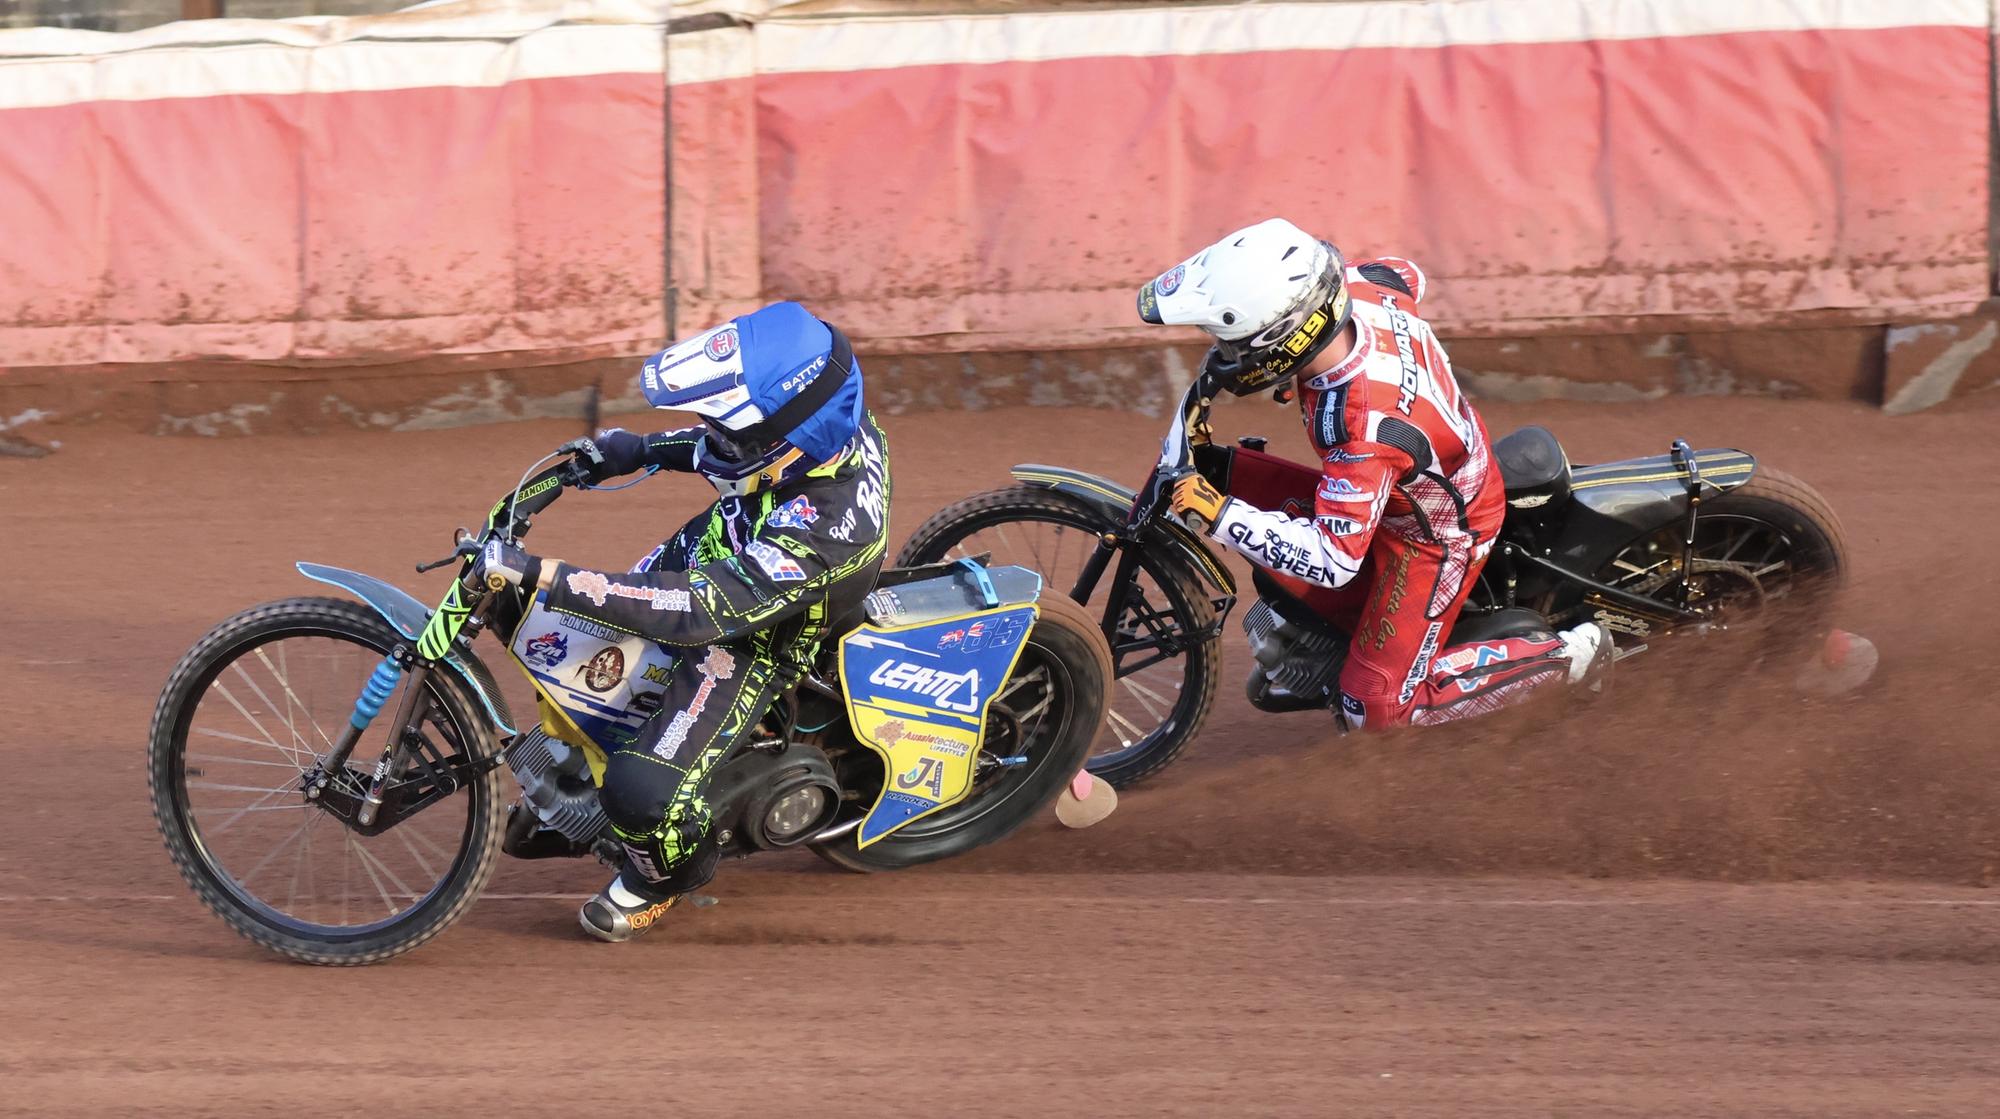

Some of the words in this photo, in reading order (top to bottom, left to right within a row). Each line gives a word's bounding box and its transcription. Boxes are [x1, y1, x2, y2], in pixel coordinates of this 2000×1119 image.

[1286, 312, 1325, 354] 29
[782, 355, 825, 391] BATTYE
[518, 477, 558, 501] BANDITS
[1228, 521, 1335, 586] GLASHEEN
[1264, 529, 1311, 561] SOPHIE
[560, 614, 625, 644] CONTRACTING
[903, 731, 970, 751] Aussietecture
[930, 745, 967, 757] LIFESTYLE
